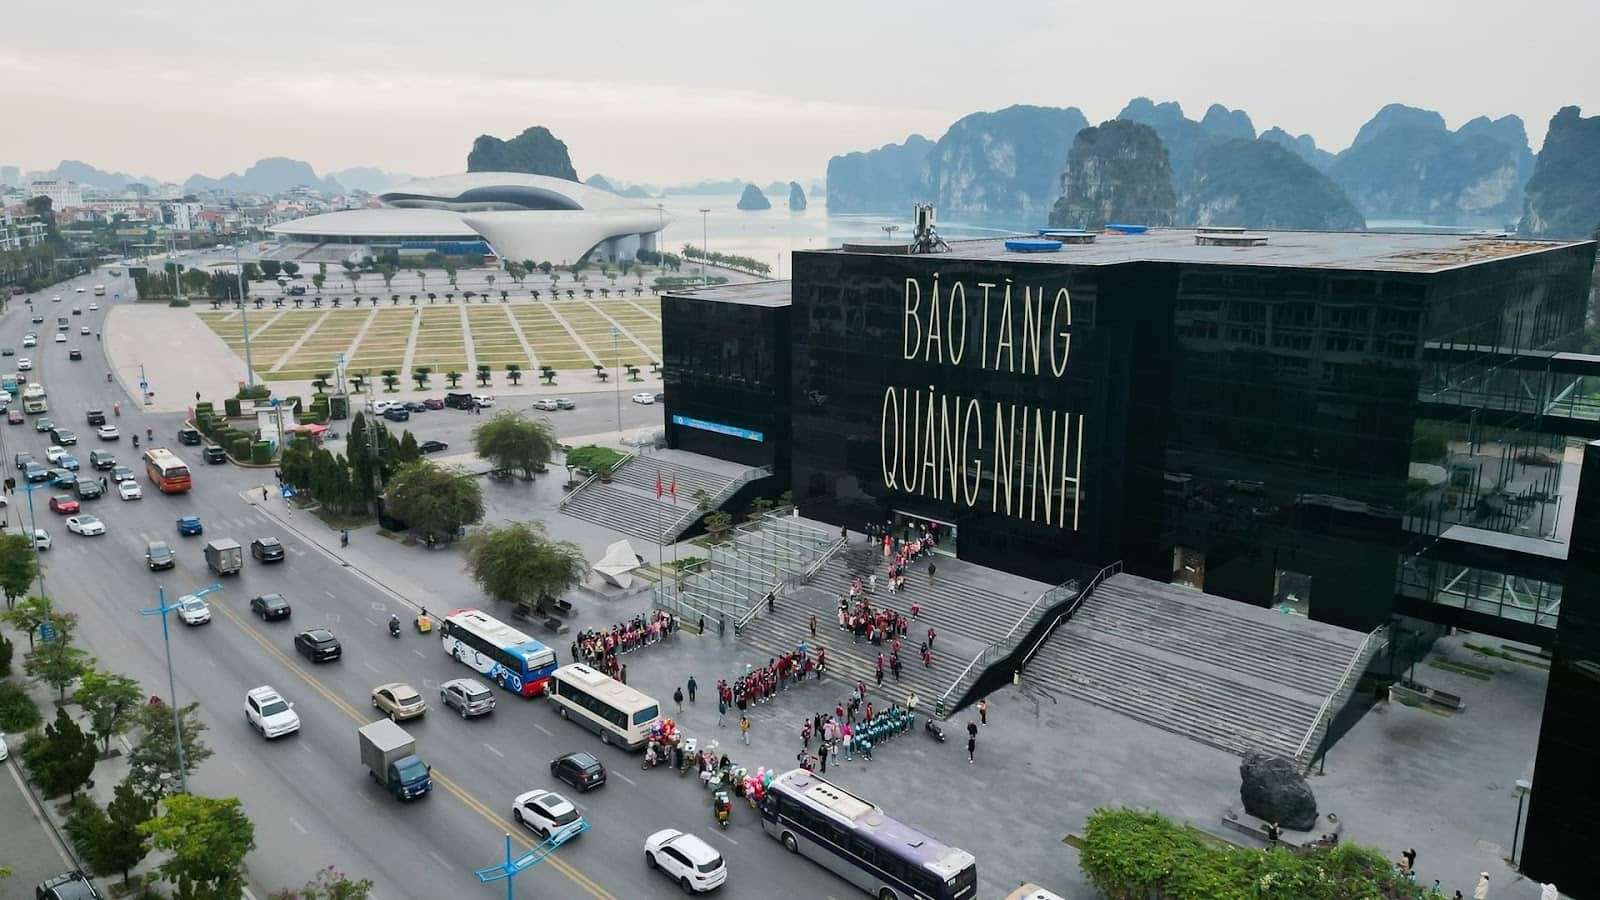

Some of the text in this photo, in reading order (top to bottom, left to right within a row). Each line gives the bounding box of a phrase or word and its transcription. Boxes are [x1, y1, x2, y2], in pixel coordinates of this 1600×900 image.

[903, 272, 1072, 378] BẢO TÀNG
[881, 384, 1084, 531] QUẢNG NINH
